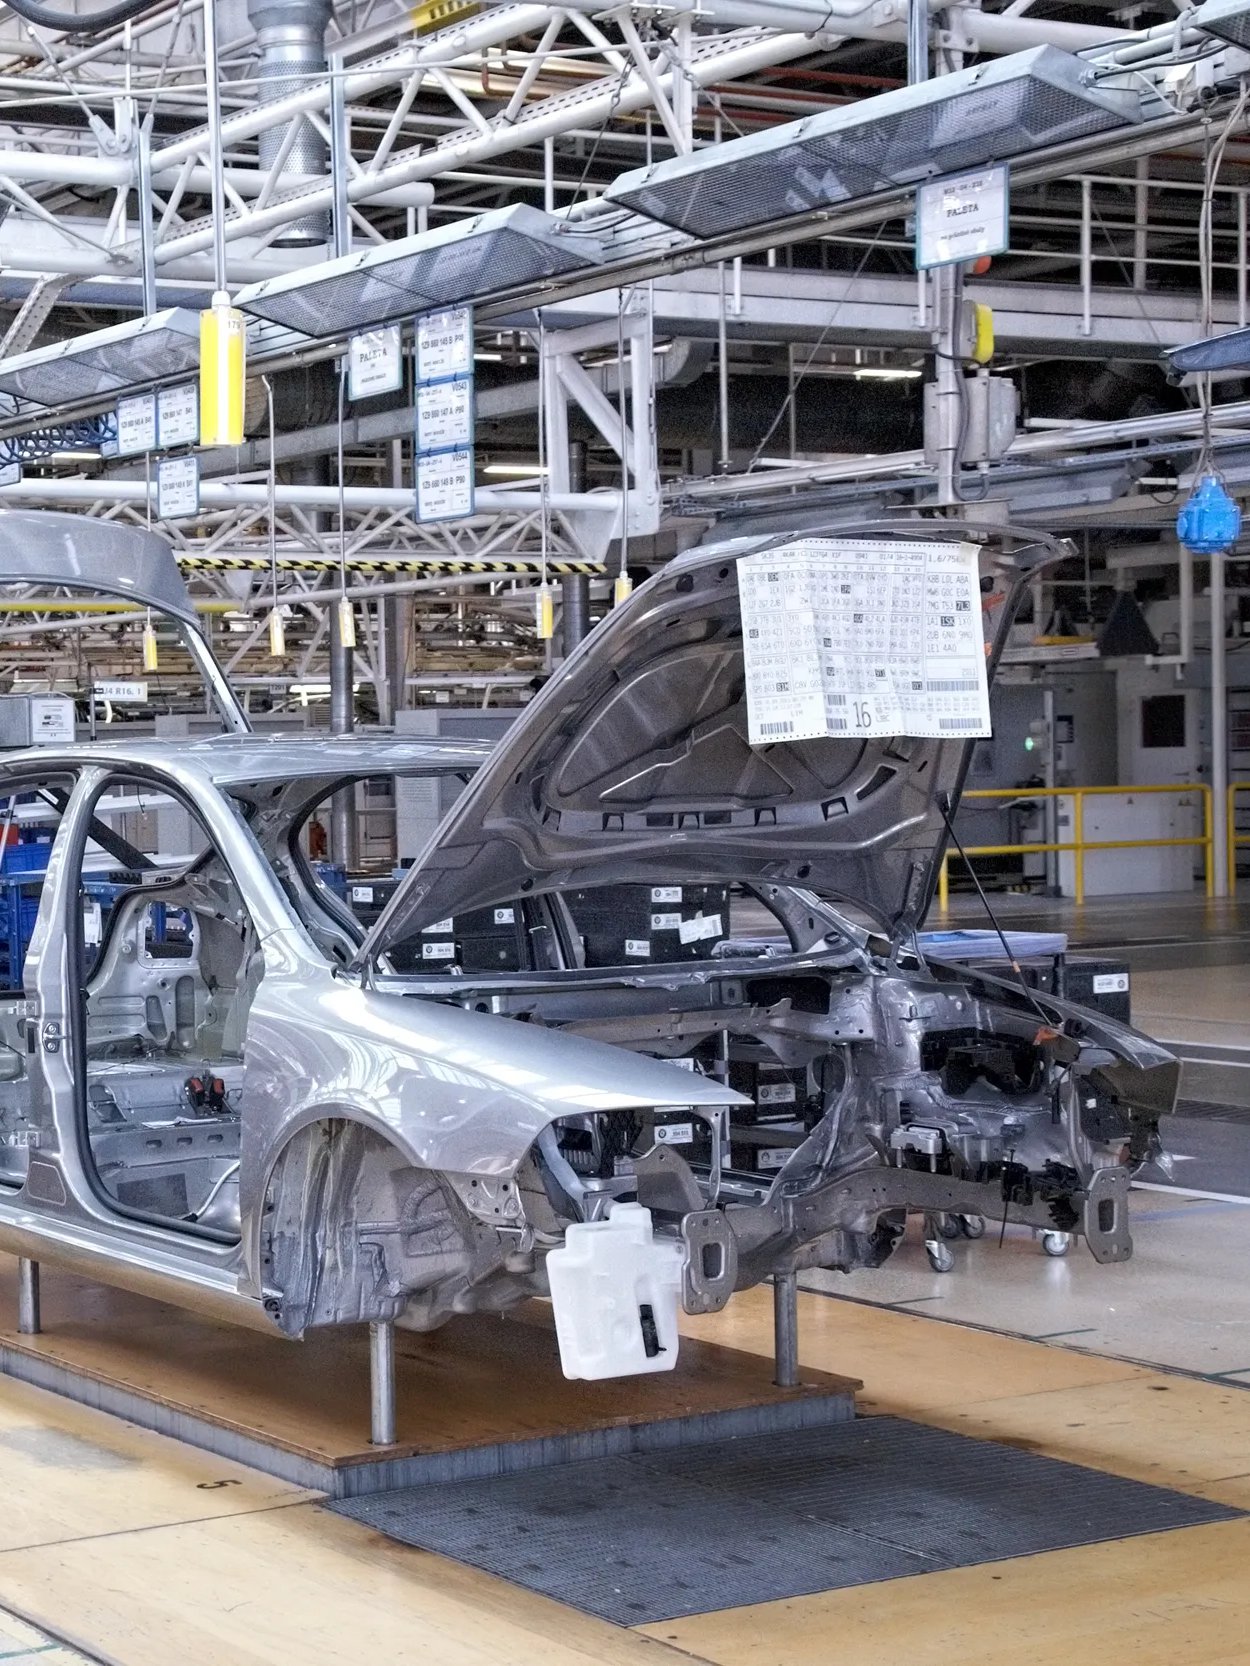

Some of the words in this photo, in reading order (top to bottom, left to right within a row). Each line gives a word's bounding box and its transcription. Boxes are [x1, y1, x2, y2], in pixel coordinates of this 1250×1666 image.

[946, 204, 979, 218] PALETA
[359, 347, 388, 363] PALETA
[852, 701, 872, 728] 16
[196, 1479, 243, 1490] 5
